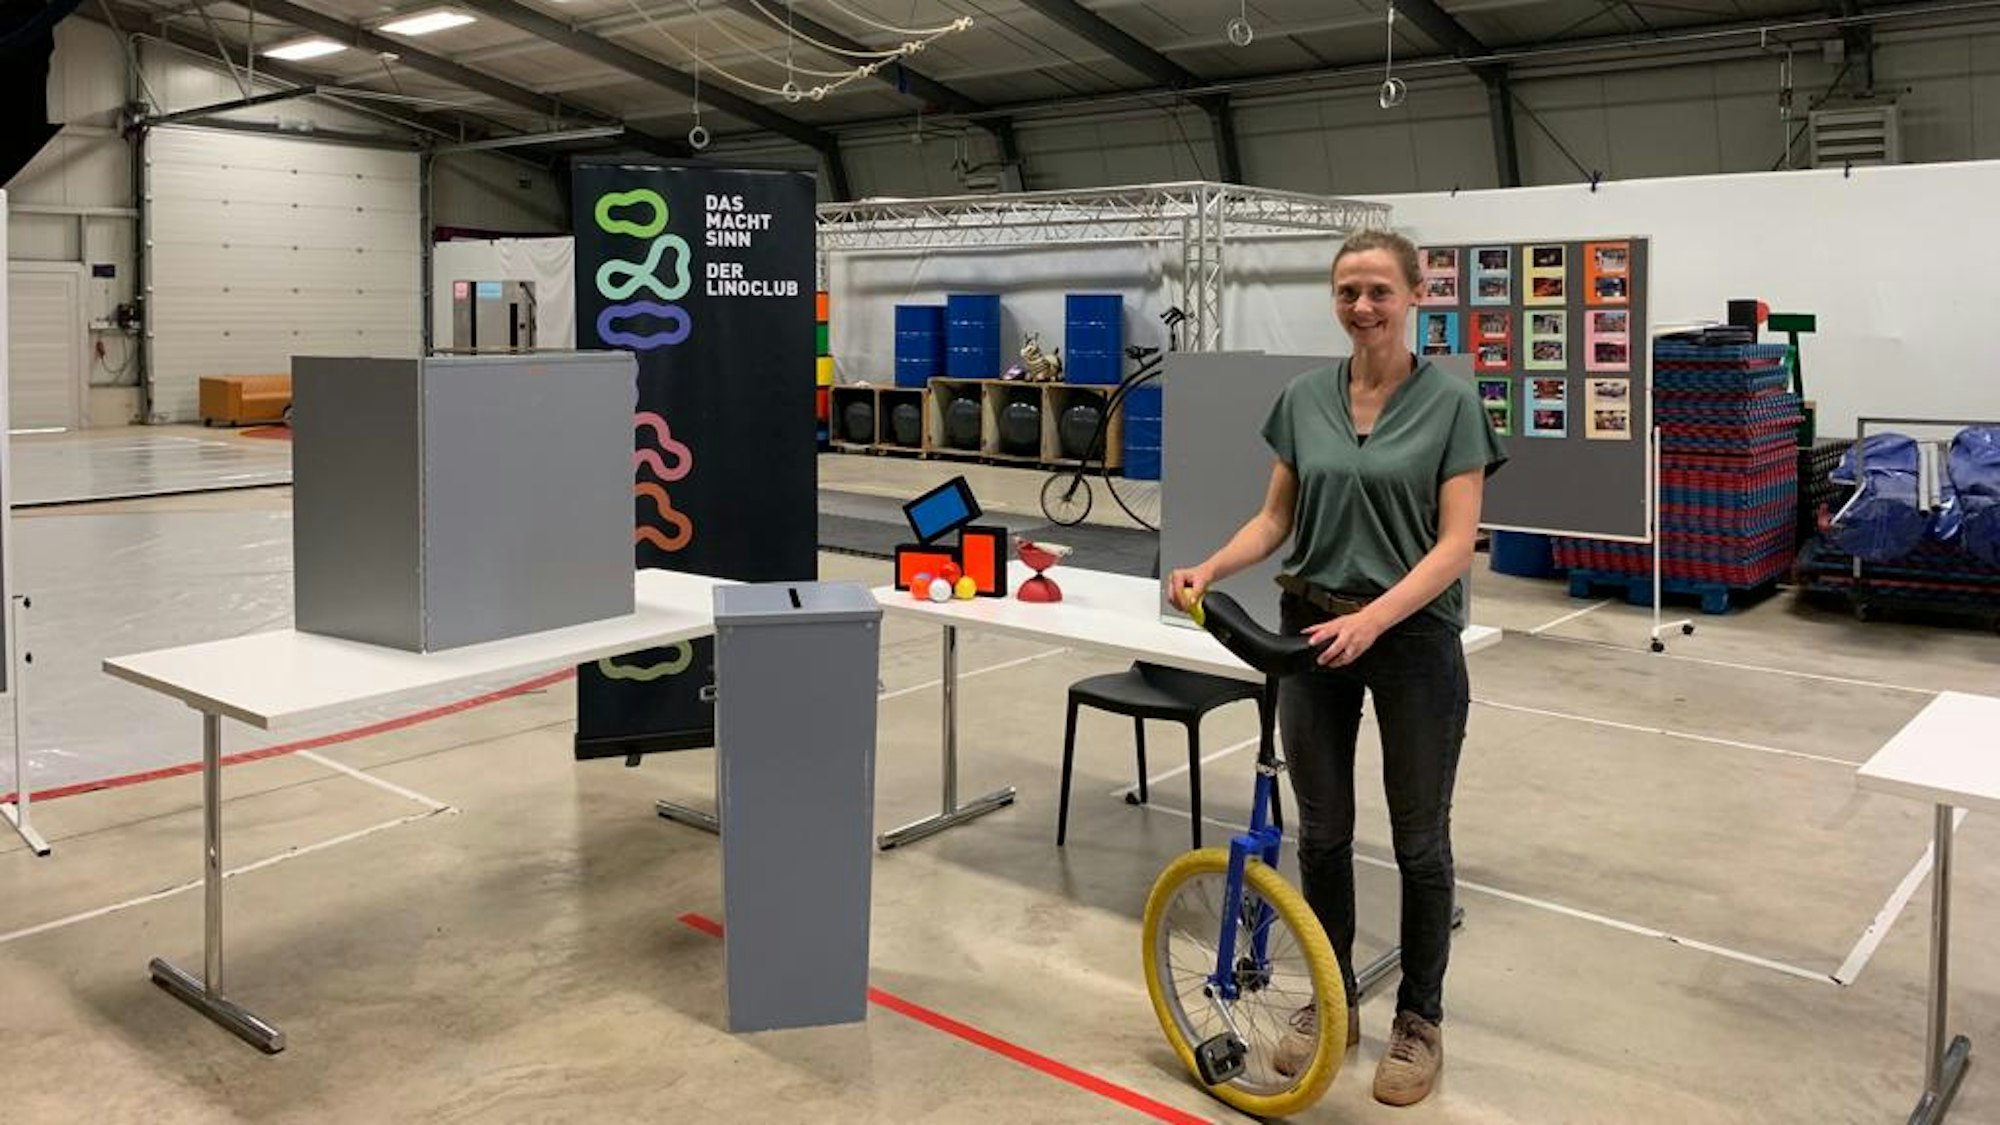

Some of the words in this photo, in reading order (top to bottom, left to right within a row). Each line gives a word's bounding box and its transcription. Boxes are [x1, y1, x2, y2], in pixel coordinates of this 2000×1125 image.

[705, 194, 744, 212] DAS
[705, 213, 772, 230] MACHT
[705, 230, 751, 248] SINN
[706, 262, 744, 279] DER
[706, 280, 799, 297] LINOCLUB
